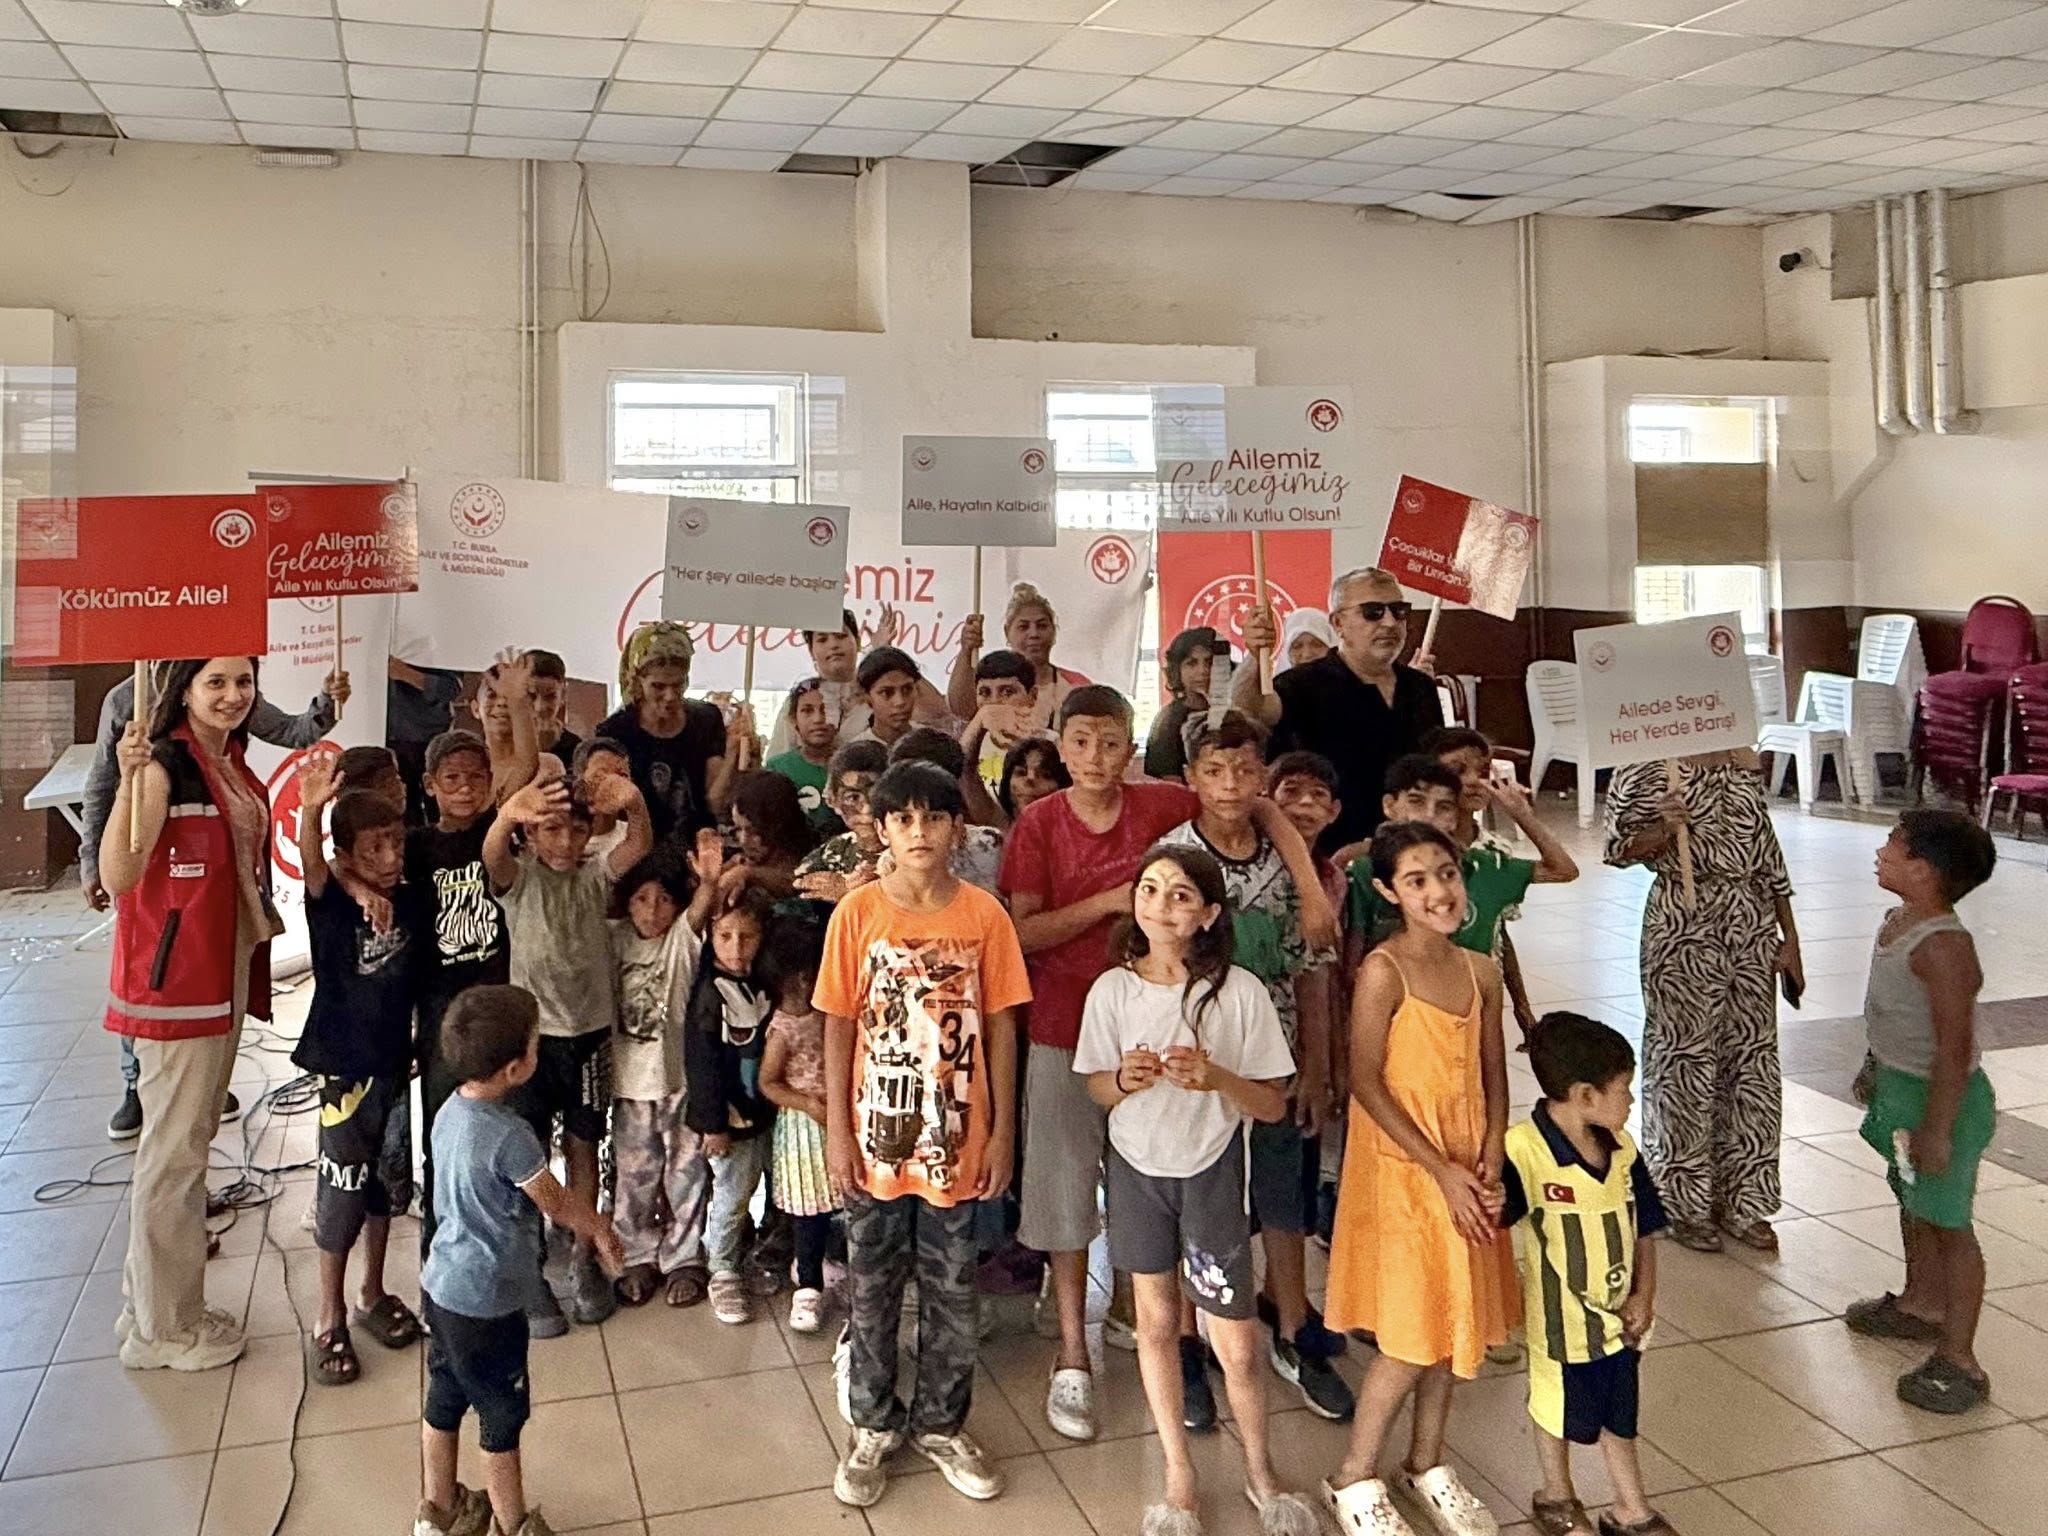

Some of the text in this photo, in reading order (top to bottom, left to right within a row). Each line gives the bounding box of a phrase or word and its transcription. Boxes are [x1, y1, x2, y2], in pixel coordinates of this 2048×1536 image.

[1228, 448, 1321, 471] Ailemiz
[1171, 460, 1350, 505] Geleceğimiz
[907, 498, 936, 512] Aile,
[939, 498, 992, 513] Hayatın
[1244, 508, 1284, 523] Kutlu
[1289, 506, 1341, 522] Olsun!
[315, 531, 389, 551] Ailemiz
[274, 580, 300, 593] Aile
[303, 580, 322, 592] Yılı
[326, 579, 358, 591] Kutlu
[705, 569, 732, 585] şey
[736, 572, 785, 586] ailede
[58, 584, 229, 610] Kökümüz Aile!
[1619, 698, 1672, 719] Ailede
[1610, 712, 1737, 745] Her Yerde Barış!
[939, 1011, 977, 1083] 34
